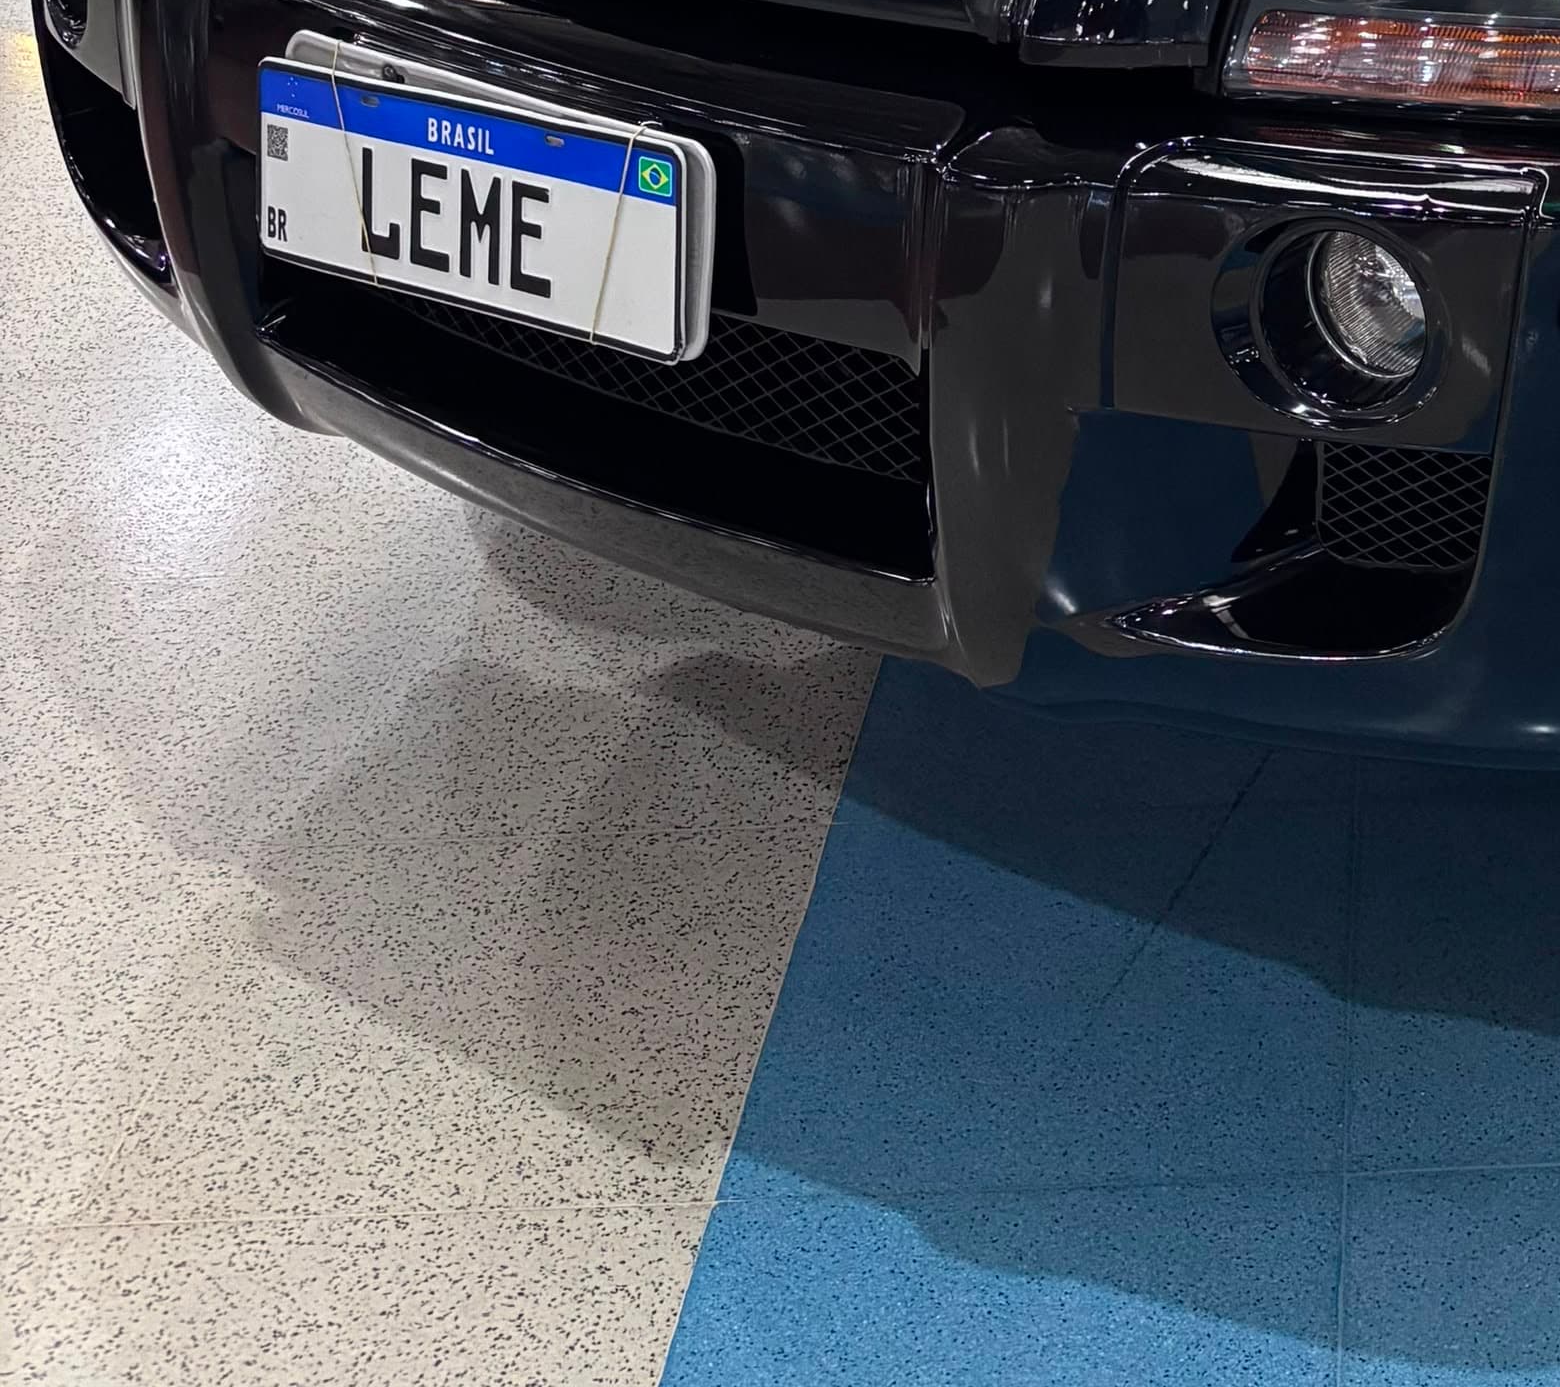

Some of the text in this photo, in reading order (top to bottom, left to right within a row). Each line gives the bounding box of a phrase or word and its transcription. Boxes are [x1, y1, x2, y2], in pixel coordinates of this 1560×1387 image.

[426, 117, 495, 156] BRASIL
[267, 205, 288, 242] BR
[361, 147, 552, 299] LEME
